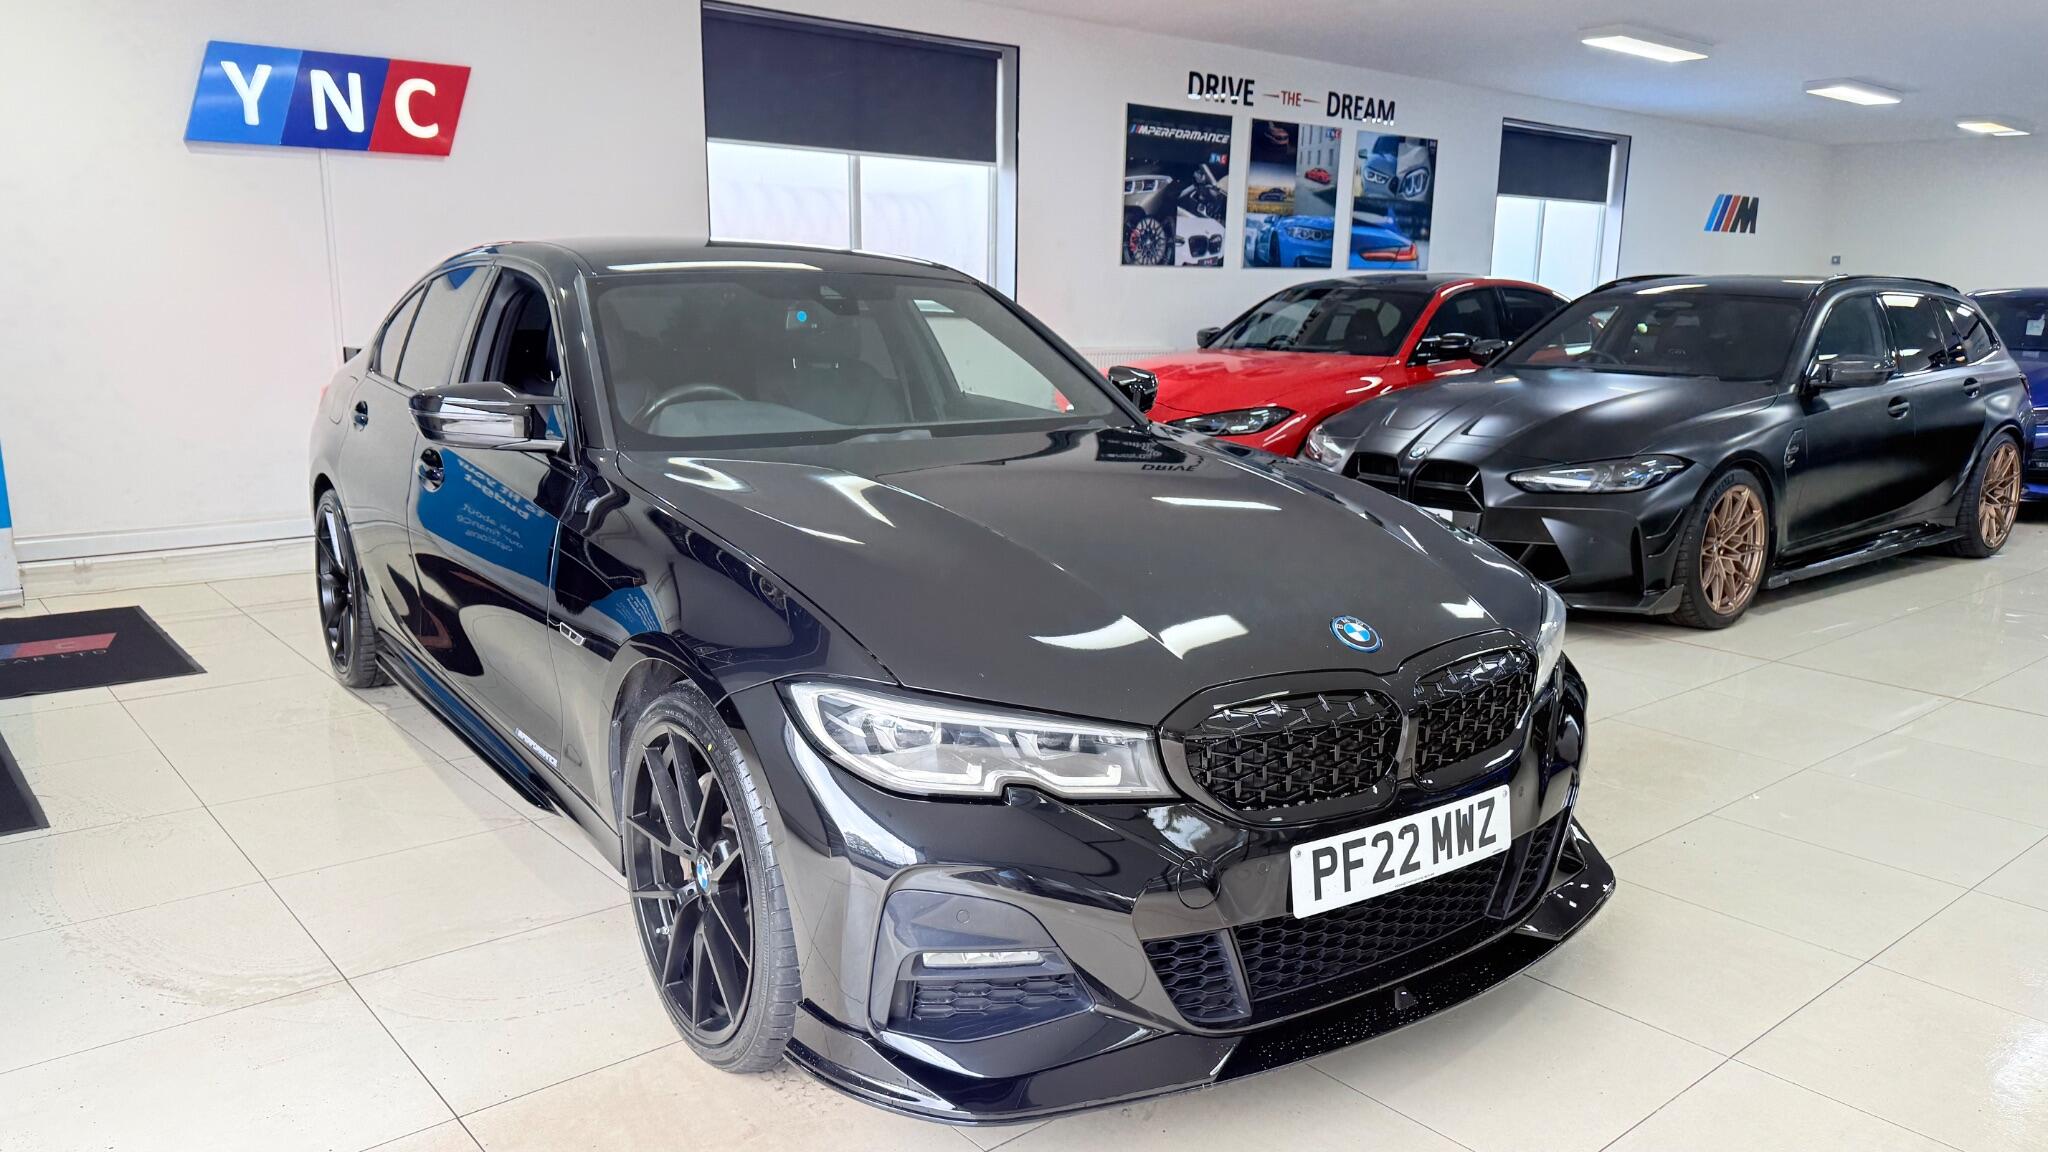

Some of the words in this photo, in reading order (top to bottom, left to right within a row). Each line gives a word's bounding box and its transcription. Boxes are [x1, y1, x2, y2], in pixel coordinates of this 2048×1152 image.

[220, 60, 440, 139] YNC
[1188, 71, 1255, 106] DRIVE
[1281, 90, 1302, 107] THE
[1327, 91, 1396, 126] DREAM
[1312, 823, 1421, 901] PF22
[1431, 797, 1497, 865] MWZ
